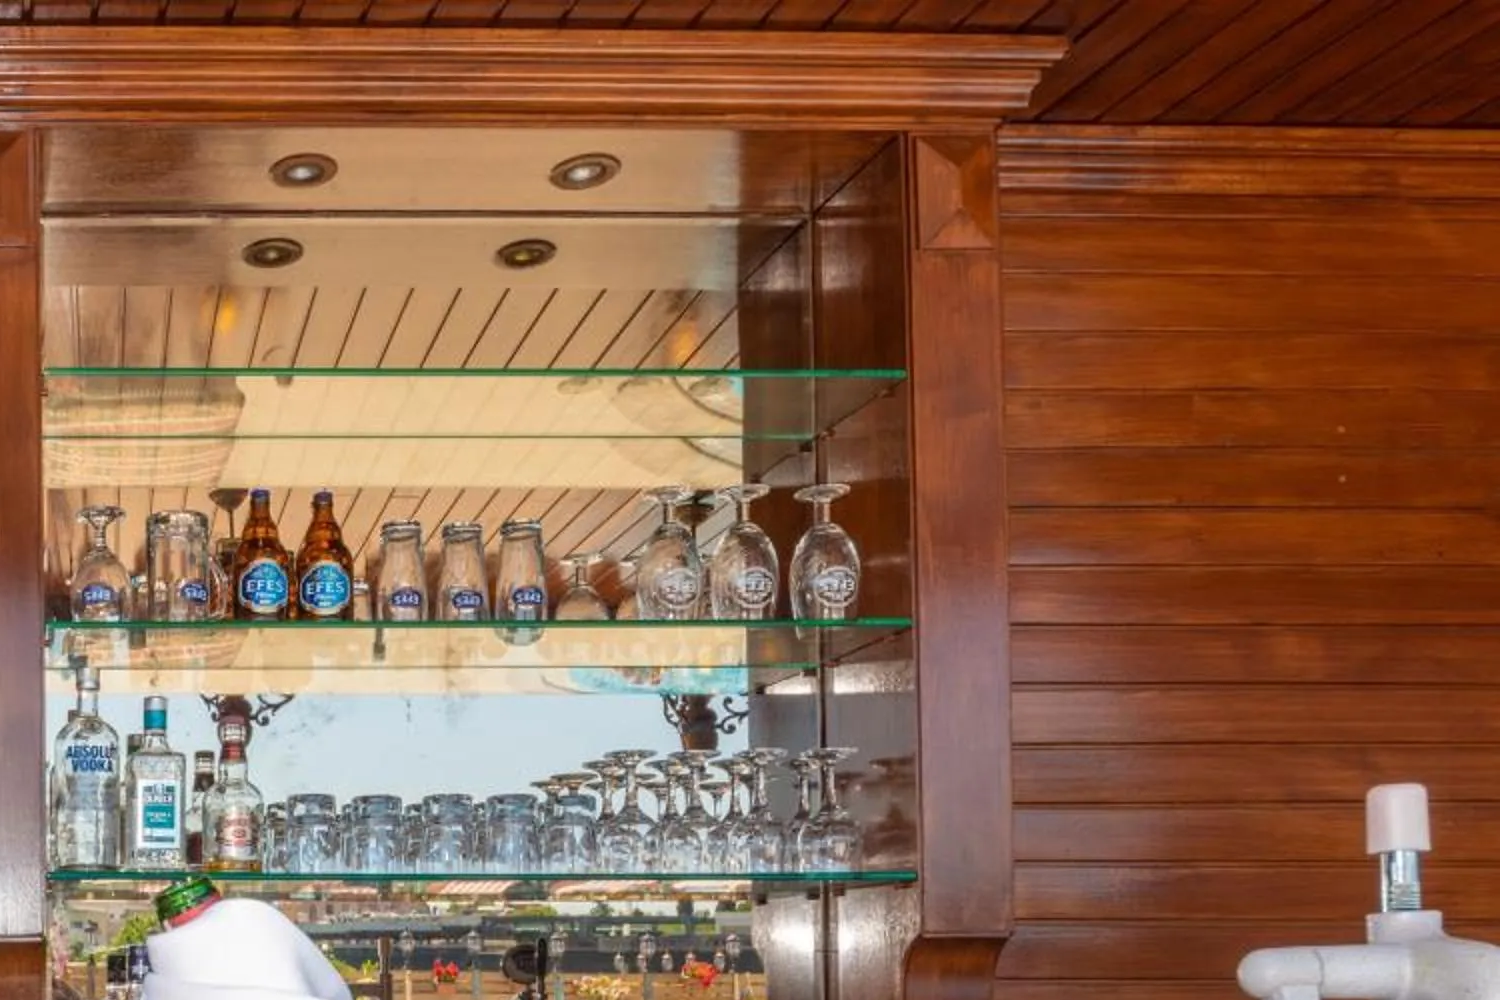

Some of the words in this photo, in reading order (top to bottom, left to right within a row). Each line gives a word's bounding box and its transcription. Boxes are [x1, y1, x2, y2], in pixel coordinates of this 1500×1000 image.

[246, 579, 285, 592] EFES
[307, 581, 346, 595] EFES
[66, 743, 116, 758] ABSOLUT
[71, 758, 114, 772] VODKA
